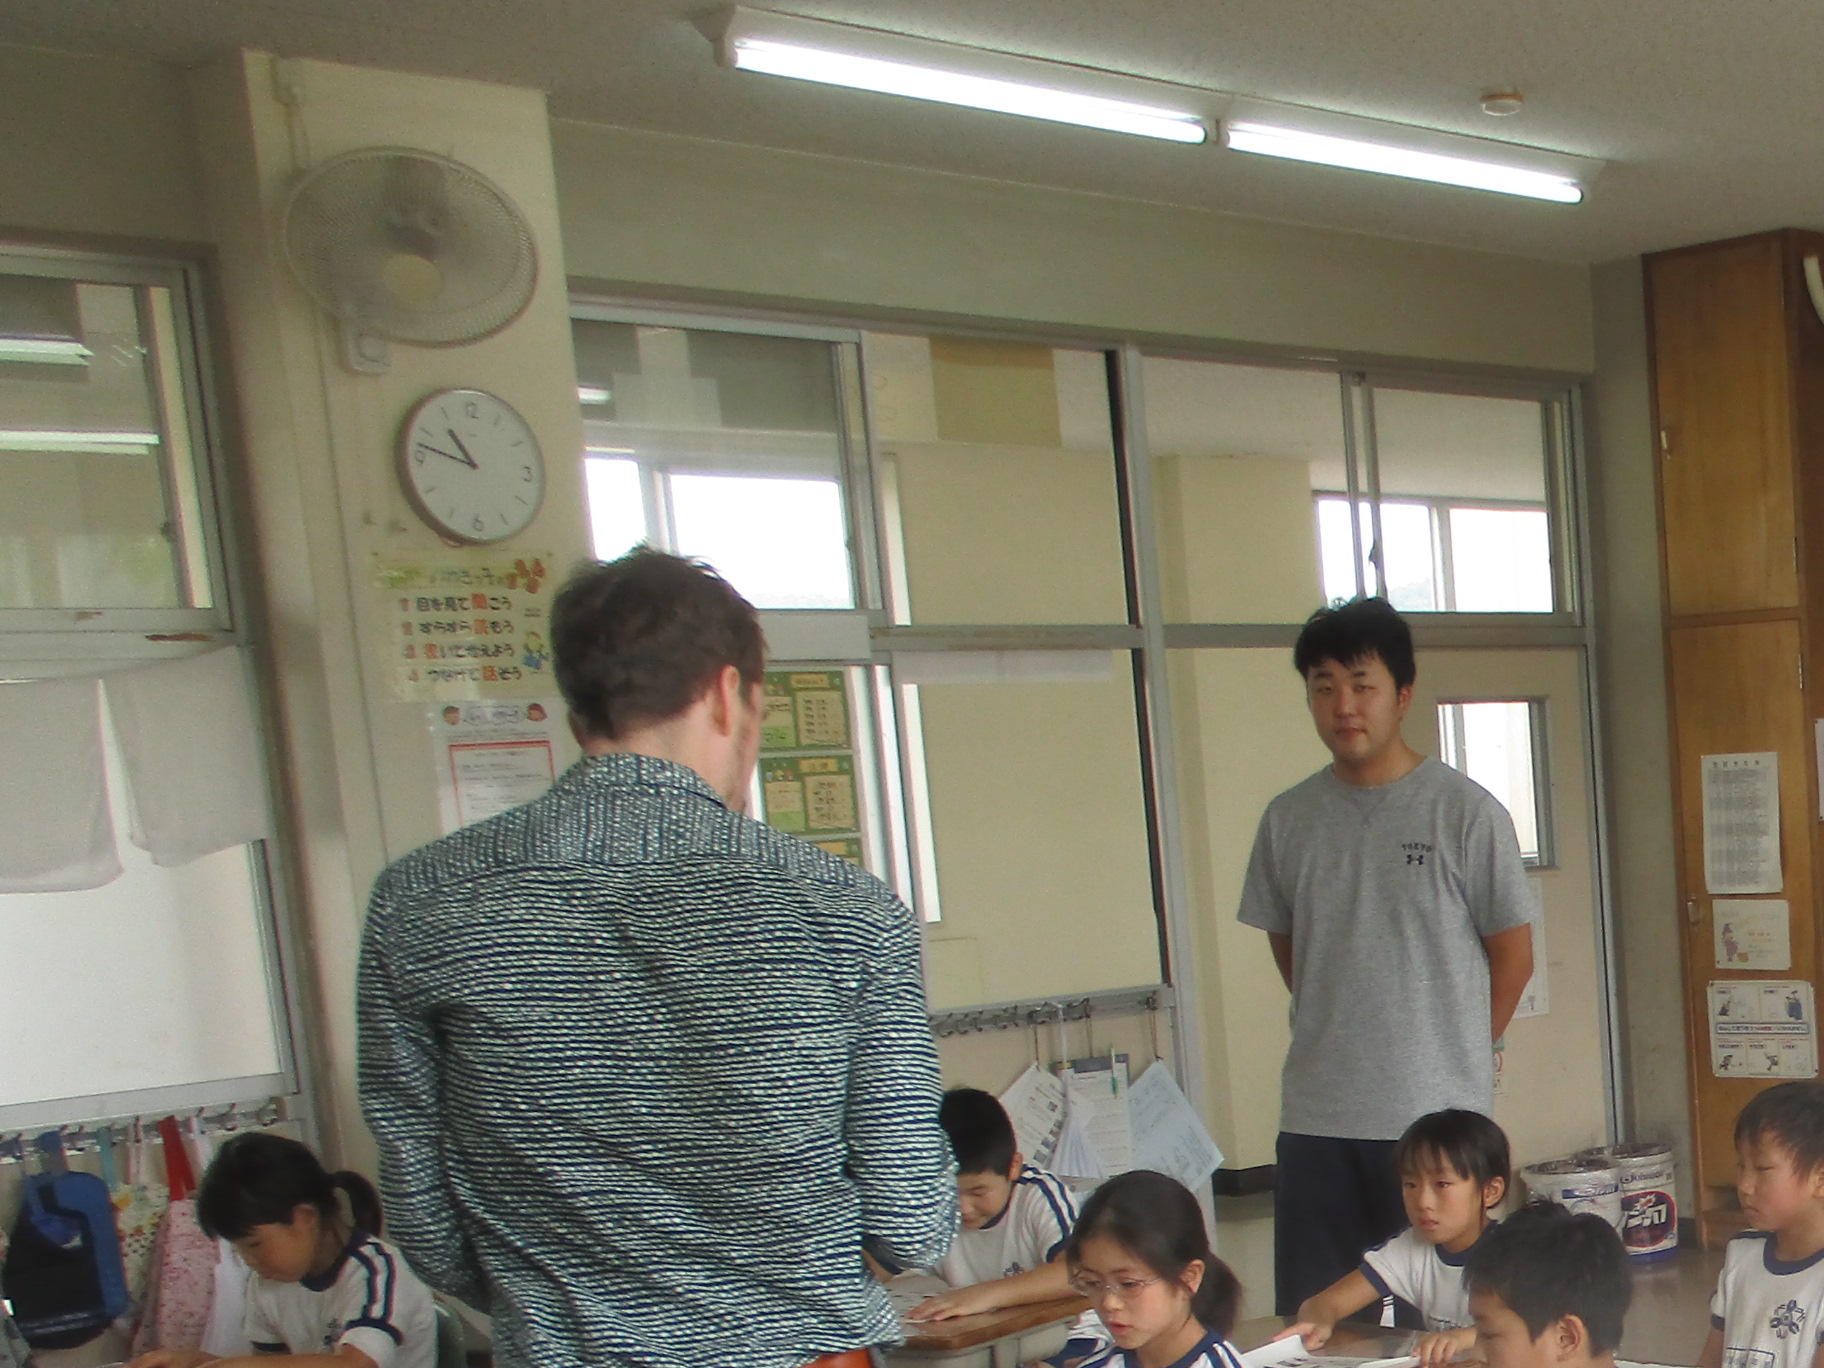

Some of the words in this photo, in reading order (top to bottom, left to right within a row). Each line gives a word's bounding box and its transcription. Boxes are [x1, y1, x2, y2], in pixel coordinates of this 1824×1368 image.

[465, 403, 479, 420] 12
[414, 448, 426, 465] 9
[522, 466, 534, 484] 3
[473, 515, 485, 532] 6
[1402, 842, 1433, 853] TOKYO
